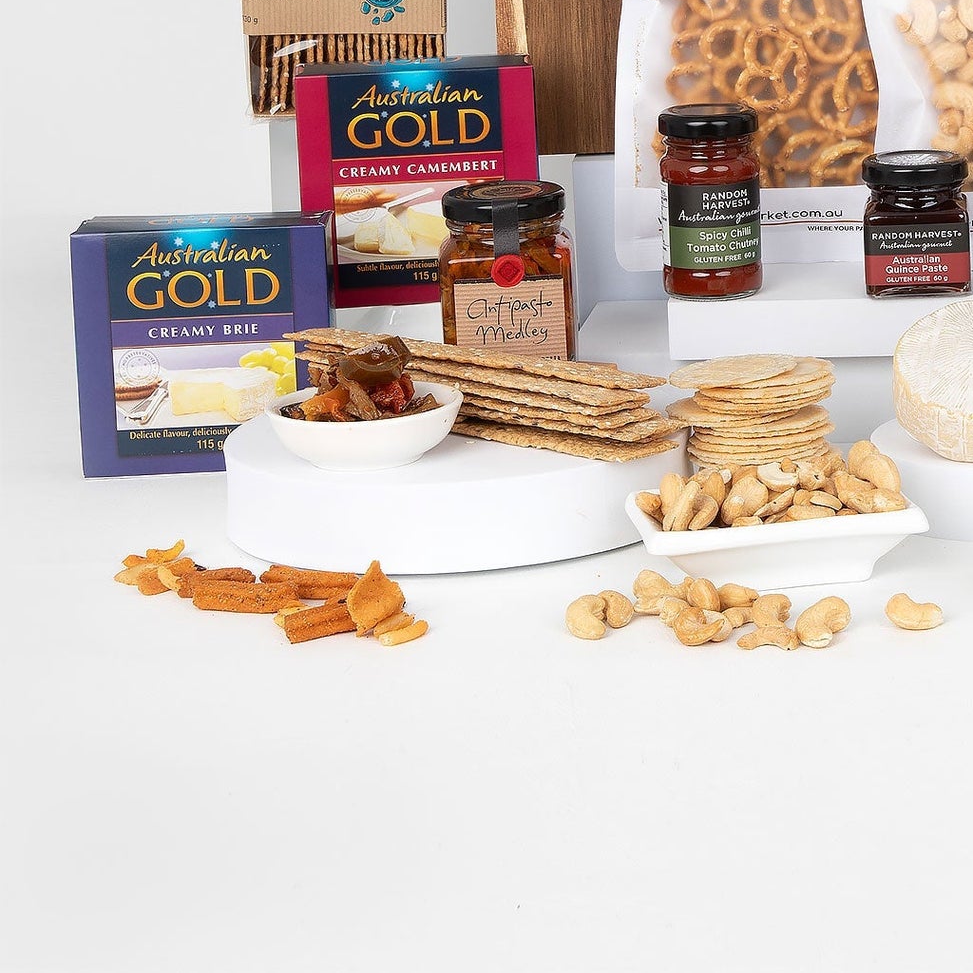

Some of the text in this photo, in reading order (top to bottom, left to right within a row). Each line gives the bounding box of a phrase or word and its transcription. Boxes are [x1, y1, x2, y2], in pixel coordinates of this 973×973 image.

[352, 81, 484, 109] Australian
[347, 109, 492, 150] GOLD
[339, 159, 498, 178] CREAMY CAMEMBERT
[702, 189, 748, 201] RANDOM
[678, 209, 735, 223] Australian
[760, 209, 843, 221] rket.com.au
[700, 226, 752, 241] Spicy Chilli
[872, 232, 912, 241] RANDOM
[686, 237, 760, 253] Tomato Chutney
[880, 241, 920, 249] Australian
[131, 238, 272, 268] Australian
[724, 253, 742, 261] FREE
[892, 255, 940, 265] Australian
[356, 263, 378, 273] Subtle
[379, 262, 405, 271] flavour,
[886, 265, 948, 275] Quince Paste
[413, 271, 438, 281] 115 g
[126, 268, 281, 311] GOLD
[148, 323, 259, 339] CREAMY BRIE
[130, 427, 232, 440] Delicate flavour, deliciously
[196, 439, 215, 449] 115
